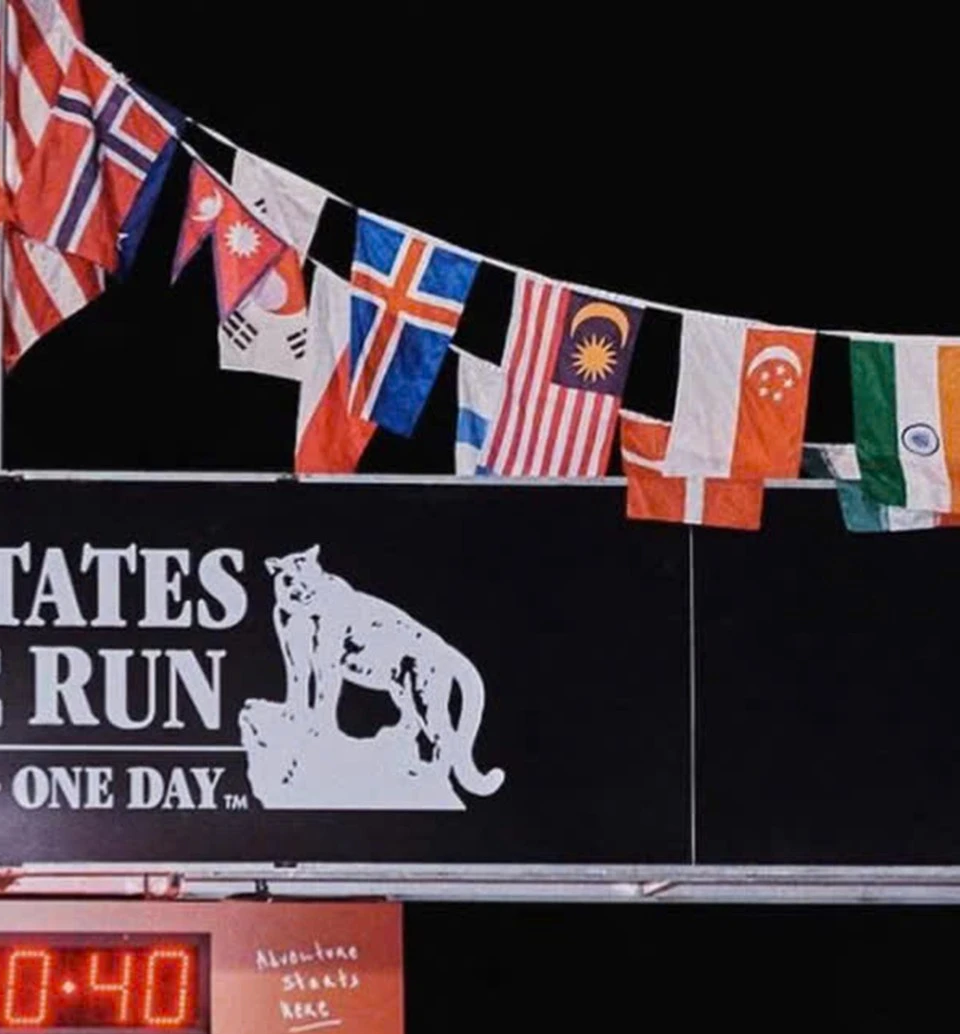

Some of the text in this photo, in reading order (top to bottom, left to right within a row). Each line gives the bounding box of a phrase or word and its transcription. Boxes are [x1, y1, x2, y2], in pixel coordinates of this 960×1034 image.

[29, 645, 227, 730] RUN
[12, 765, 114, 810] ONE
[126, 766, 227, 810] DAY
